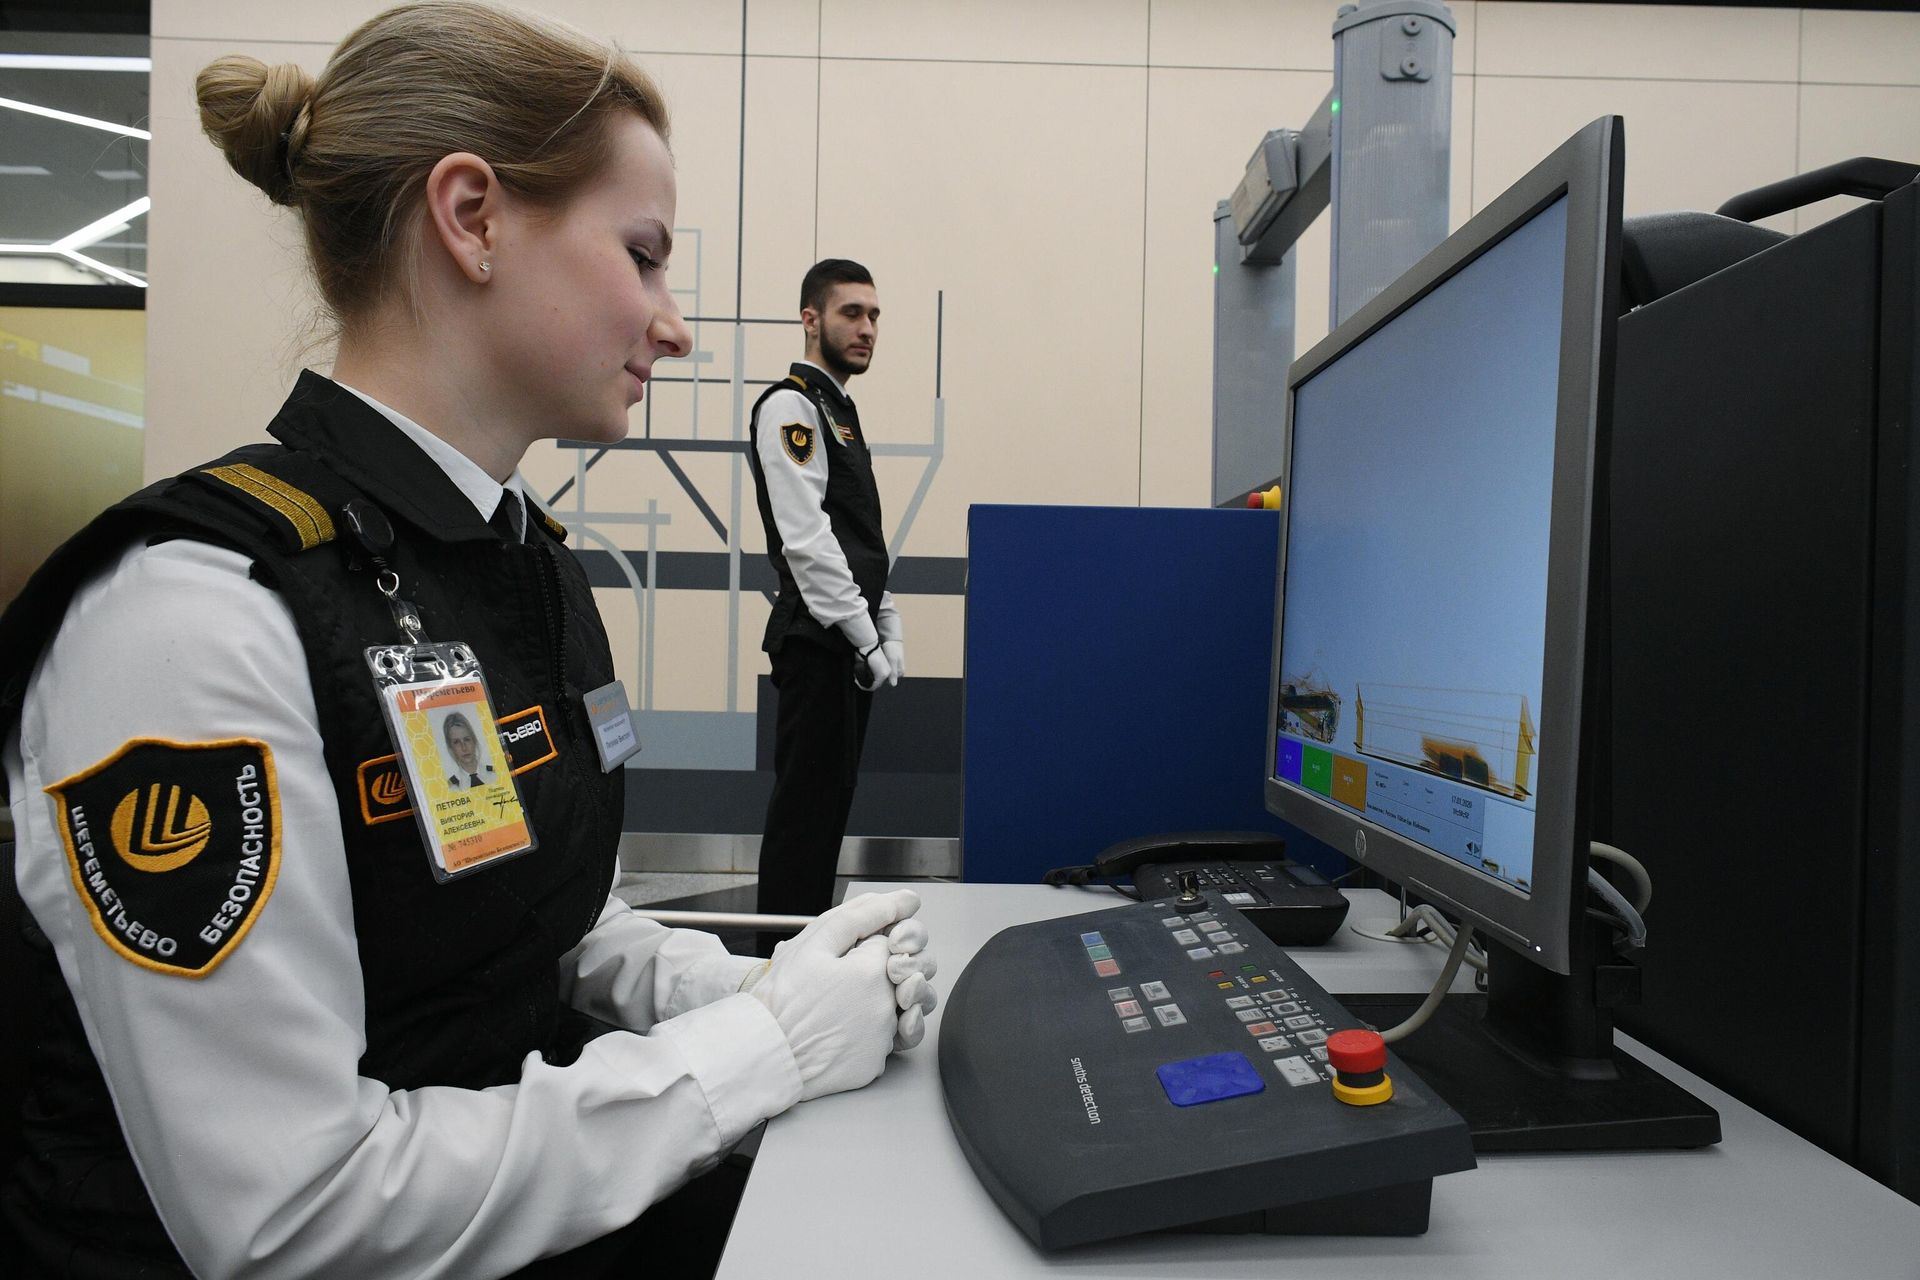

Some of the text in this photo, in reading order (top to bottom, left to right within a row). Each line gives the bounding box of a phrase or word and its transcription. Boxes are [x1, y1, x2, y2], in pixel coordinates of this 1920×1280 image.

[436, 796, 472, 811] ПЕТРОВА
[440, 810, 475, 826] ВИКТОРИЯ
[443, 818, 486, 836] АЛЕКСЕЕВНА
[199, 764, 264, 945] БЕЗОПАСНОСТЬ
[70, 805, 178, 958] ШЕРЕМЕТЬЕВО
[1070, 1057, 1101, 1125] smiths detection
